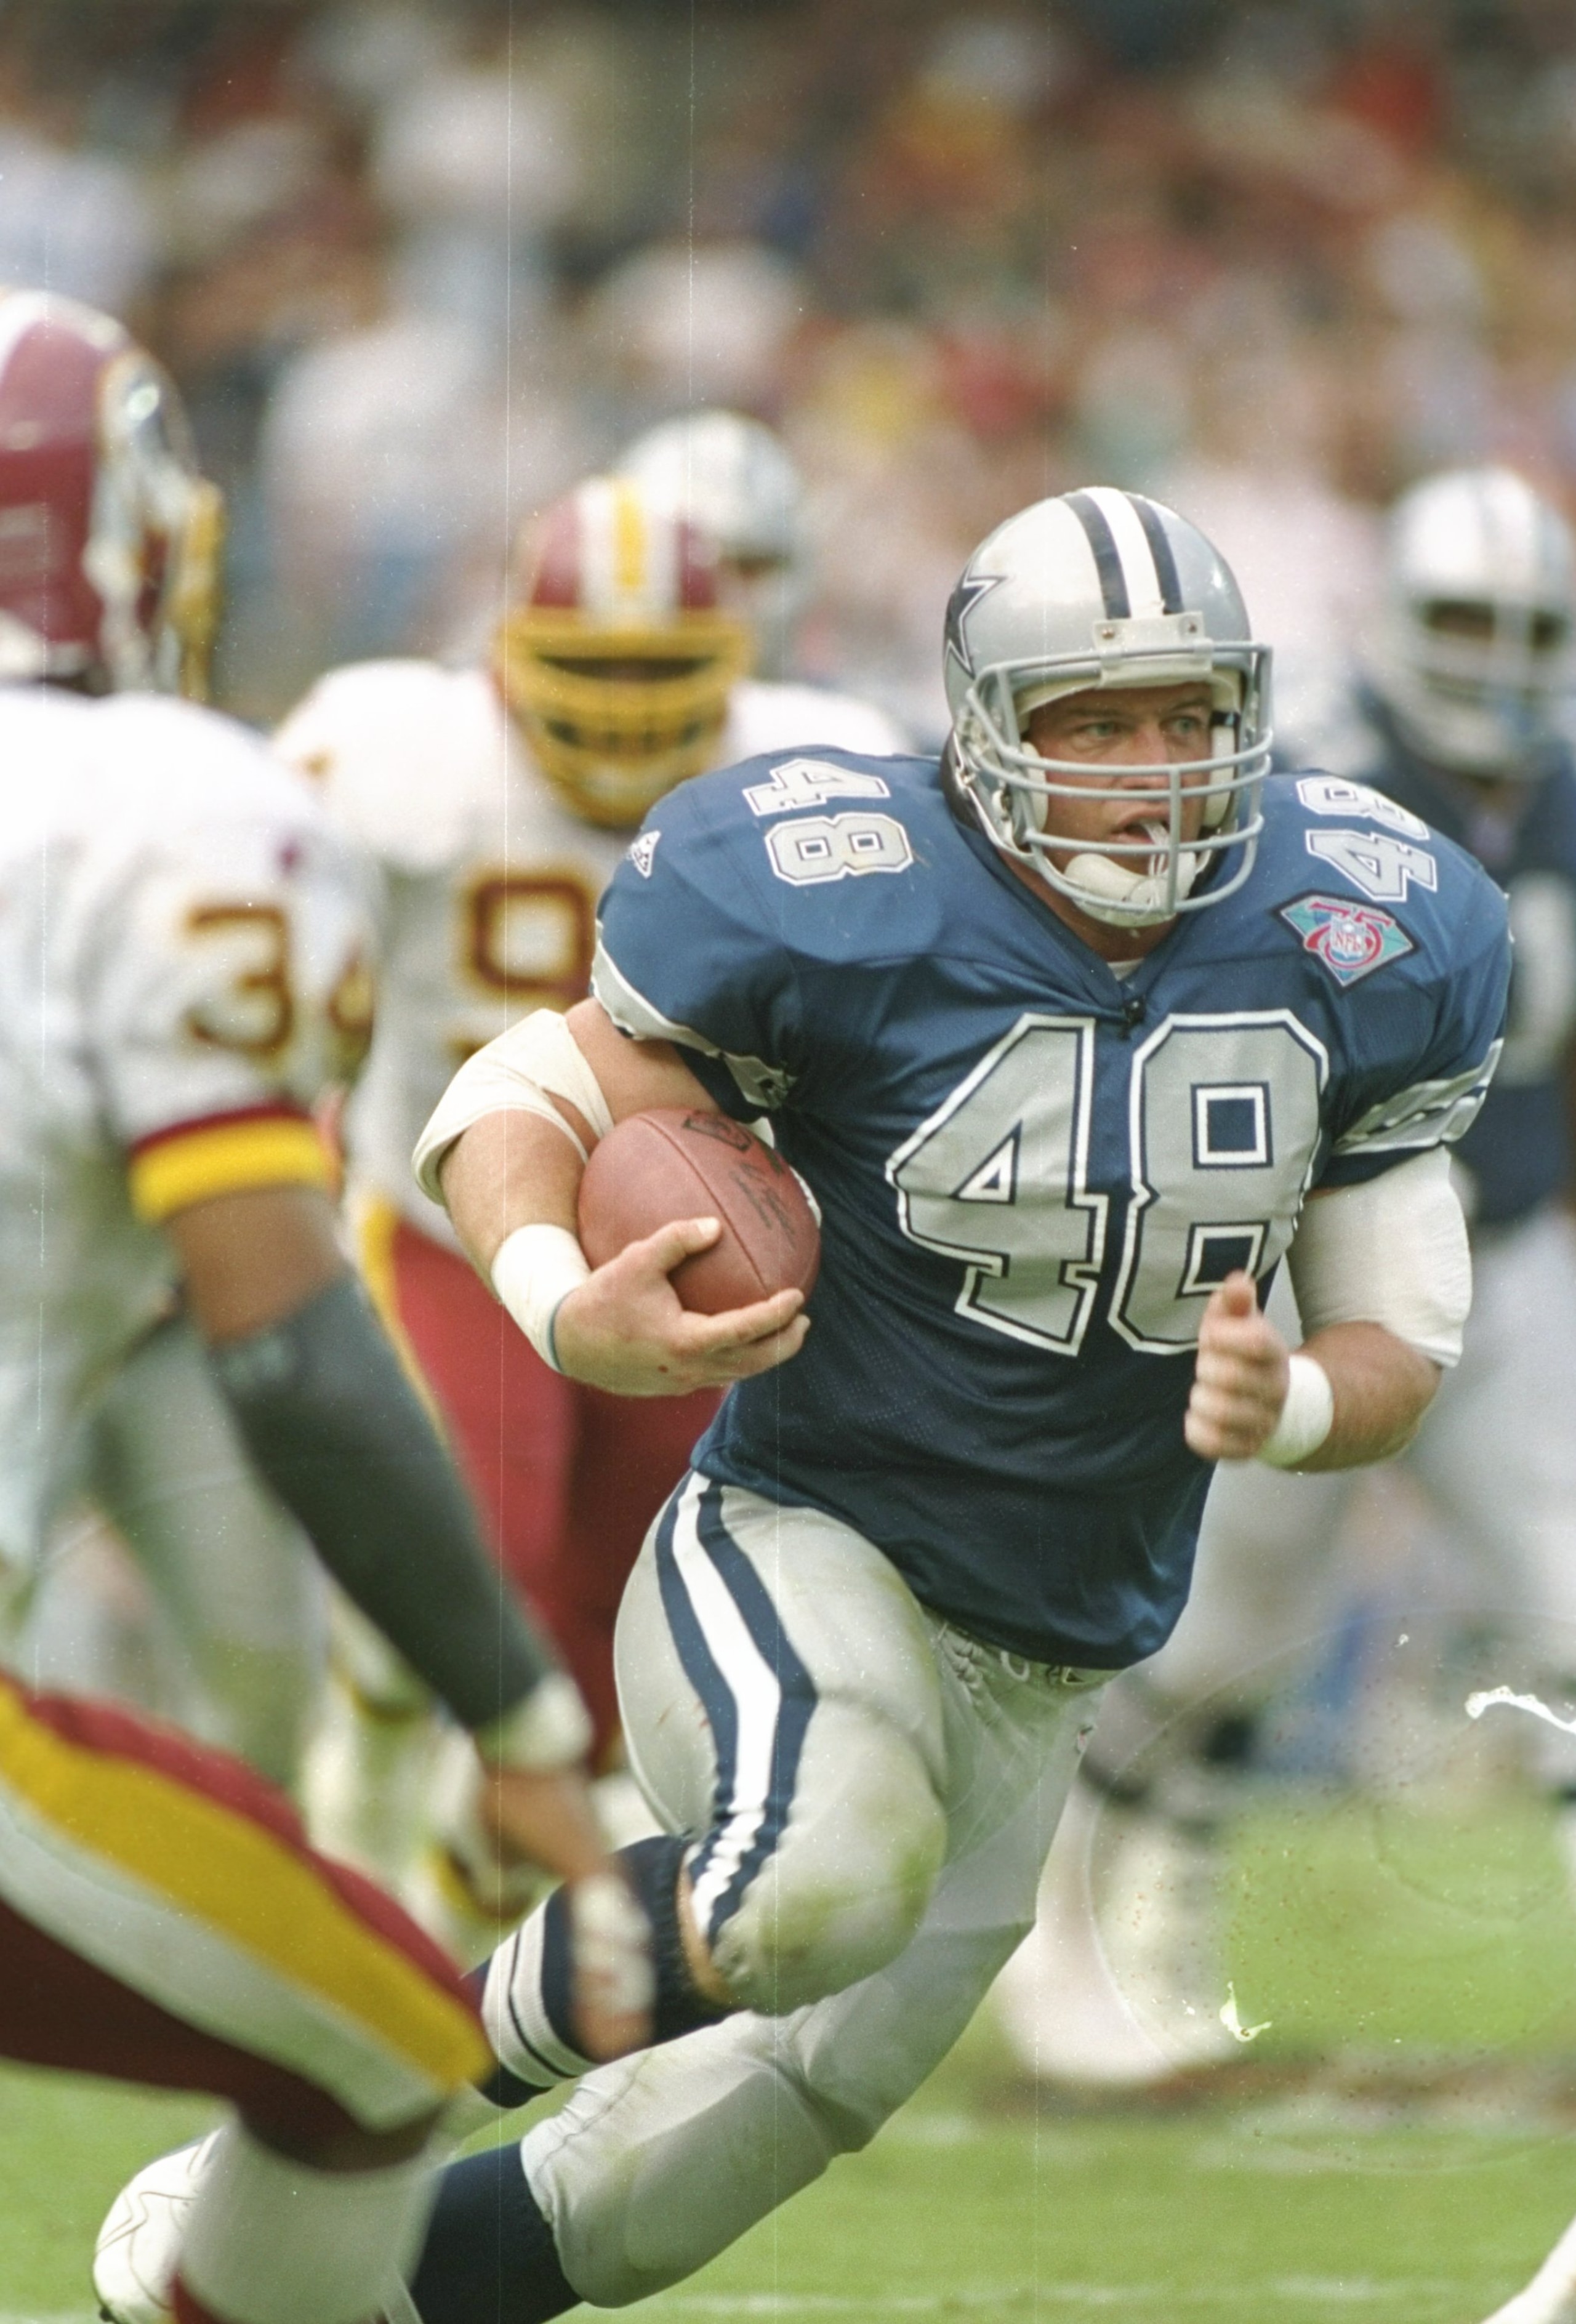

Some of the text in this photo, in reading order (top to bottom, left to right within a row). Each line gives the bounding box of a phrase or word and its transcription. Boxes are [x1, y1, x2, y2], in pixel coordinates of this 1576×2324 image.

[742, 758, 913, 887] 48
[1297, 776, 1437, 902] 48
[1334, 931, 1363, 953] NFL
[885, 1008, 1330, 1357] 48
